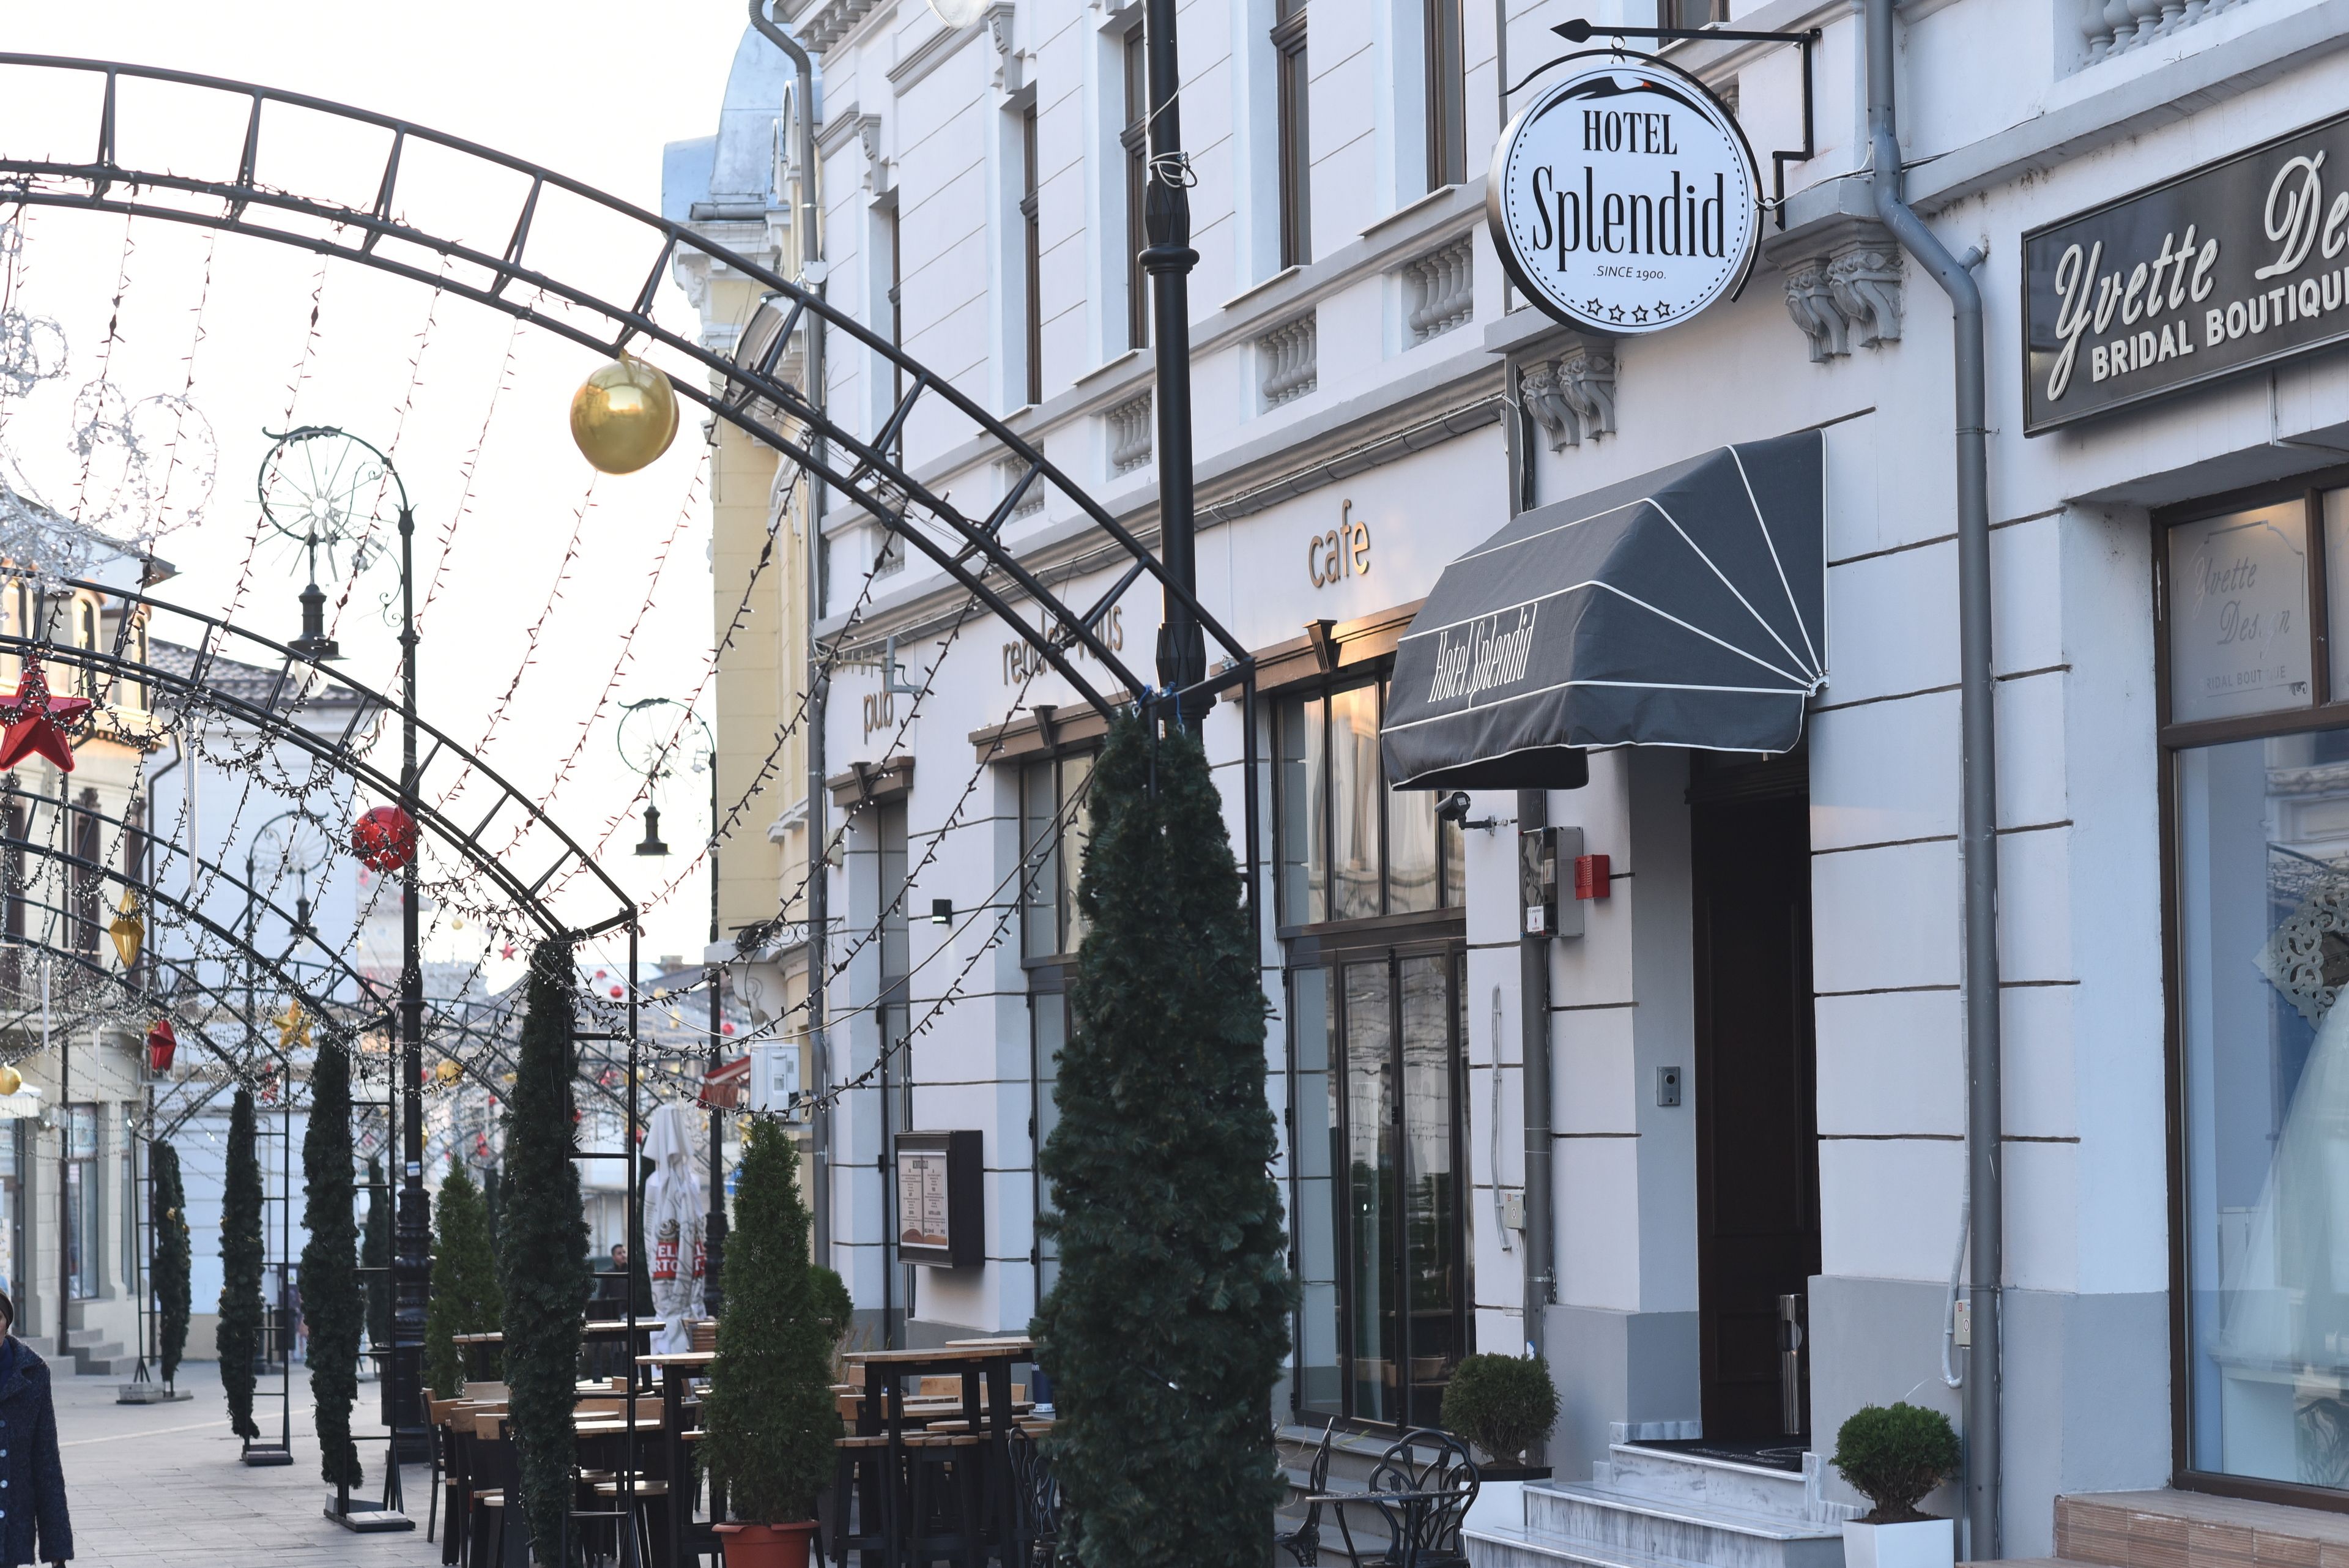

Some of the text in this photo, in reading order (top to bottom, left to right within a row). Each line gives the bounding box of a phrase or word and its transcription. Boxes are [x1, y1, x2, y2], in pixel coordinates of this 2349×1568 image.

[1583, 110, 1677, 155] HOTEL
[1532, 165, 1726, 272] Splendid
[2047, 150, 2349, 401] Yvette De
[2092, 319, 2195, 382] BRIDAL
[1308, 499, 1370, 588] cafe
[2192, 556, 2257, 621] Yvette
[1427, 602, 1538, 708] Hotel Splendid
[2200, 674, 2233, 691] RIDAL
[864, 671, 894, 746] pub
